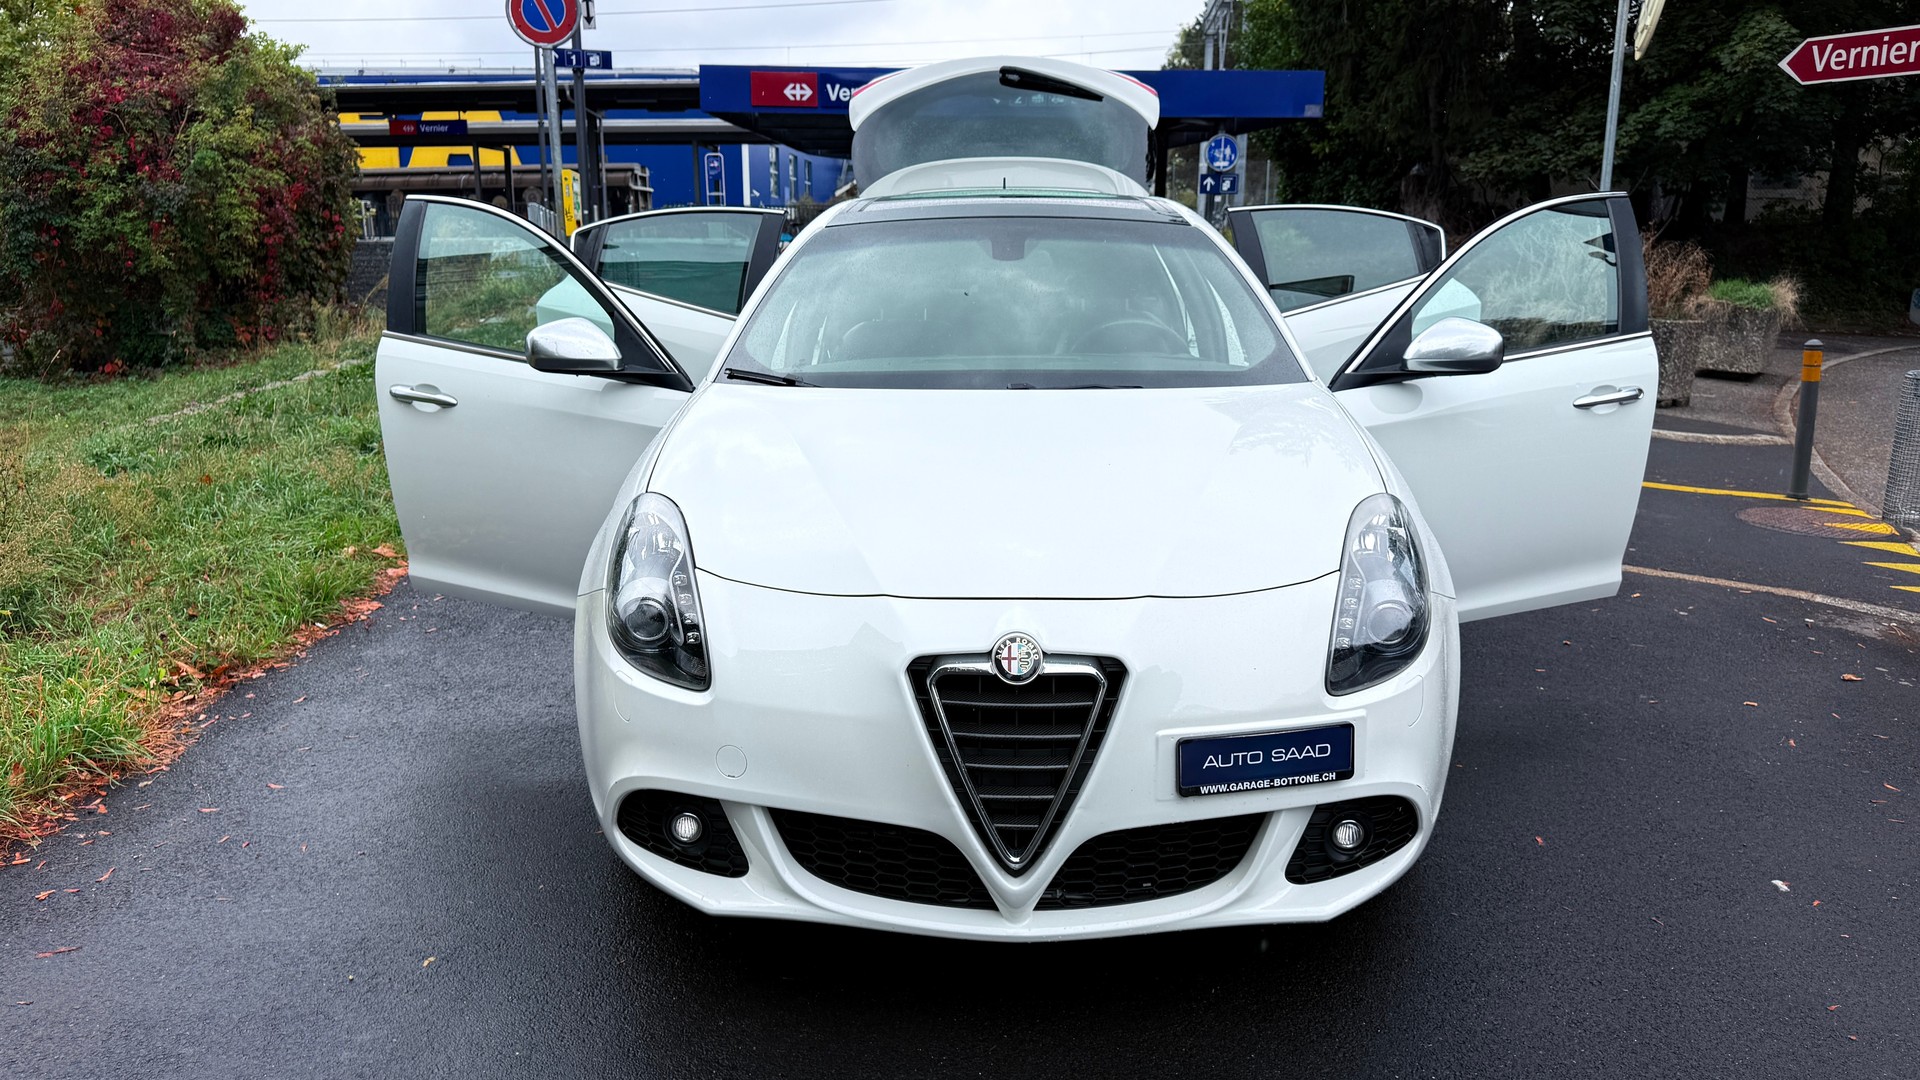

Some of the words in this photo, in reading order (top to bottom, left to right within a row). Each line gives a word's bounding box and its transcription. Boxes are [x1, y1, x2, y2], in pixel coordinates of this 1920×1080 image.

[570, 54, 576, 66] 1
[1812, 36, 1920, 72] Vernier
[420, 124, 449, 132] Vernier
[996, 640, 1012, 660] ALFA
[1016, 637, 1039, 660] ROMEO
[1202, 751, 1263, 769] AUTO
[1271, 743, 1331, 762] SAAD
[1200, 772, 1336, 794] WWW.GARAGE-BOTTONE.CH
